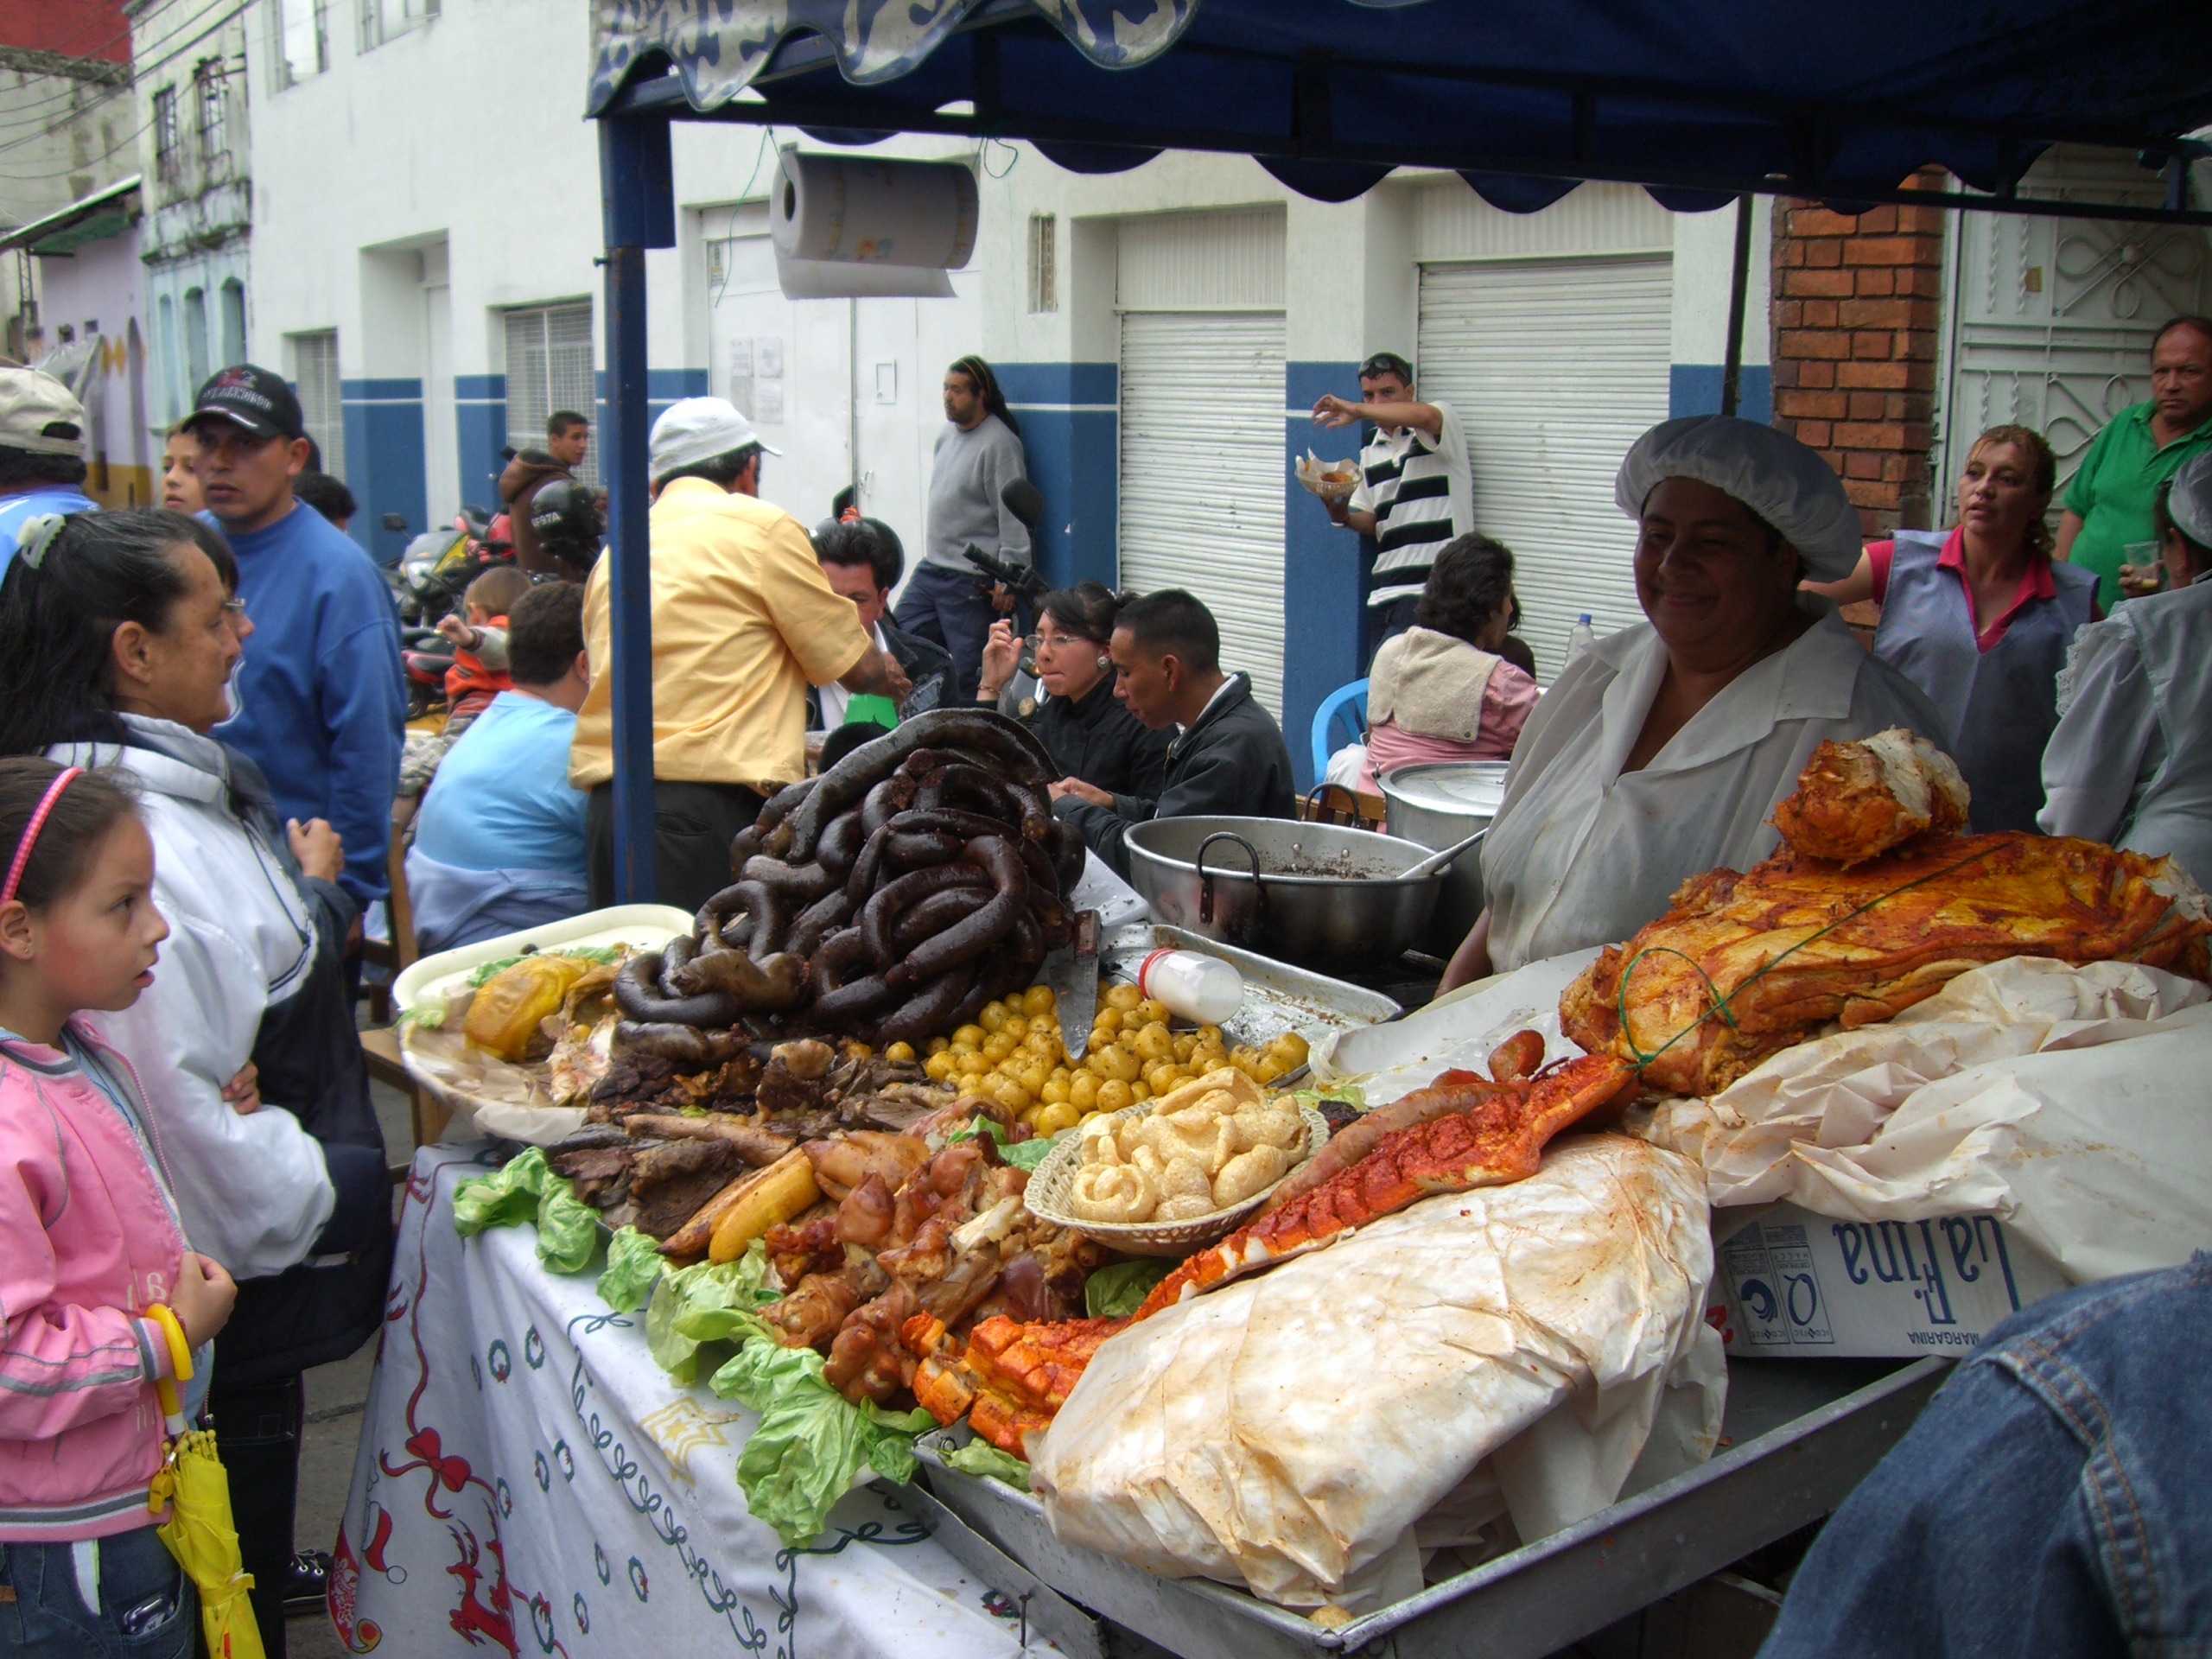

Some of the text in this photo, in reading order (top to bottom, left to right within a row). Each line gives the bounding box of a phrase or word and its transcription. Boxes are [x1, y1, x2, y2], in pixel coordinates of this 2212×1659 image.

[1832, 1216, 2021, 1325] La Fina
[1906, 1331, 1980, 1346] MARGARINA
